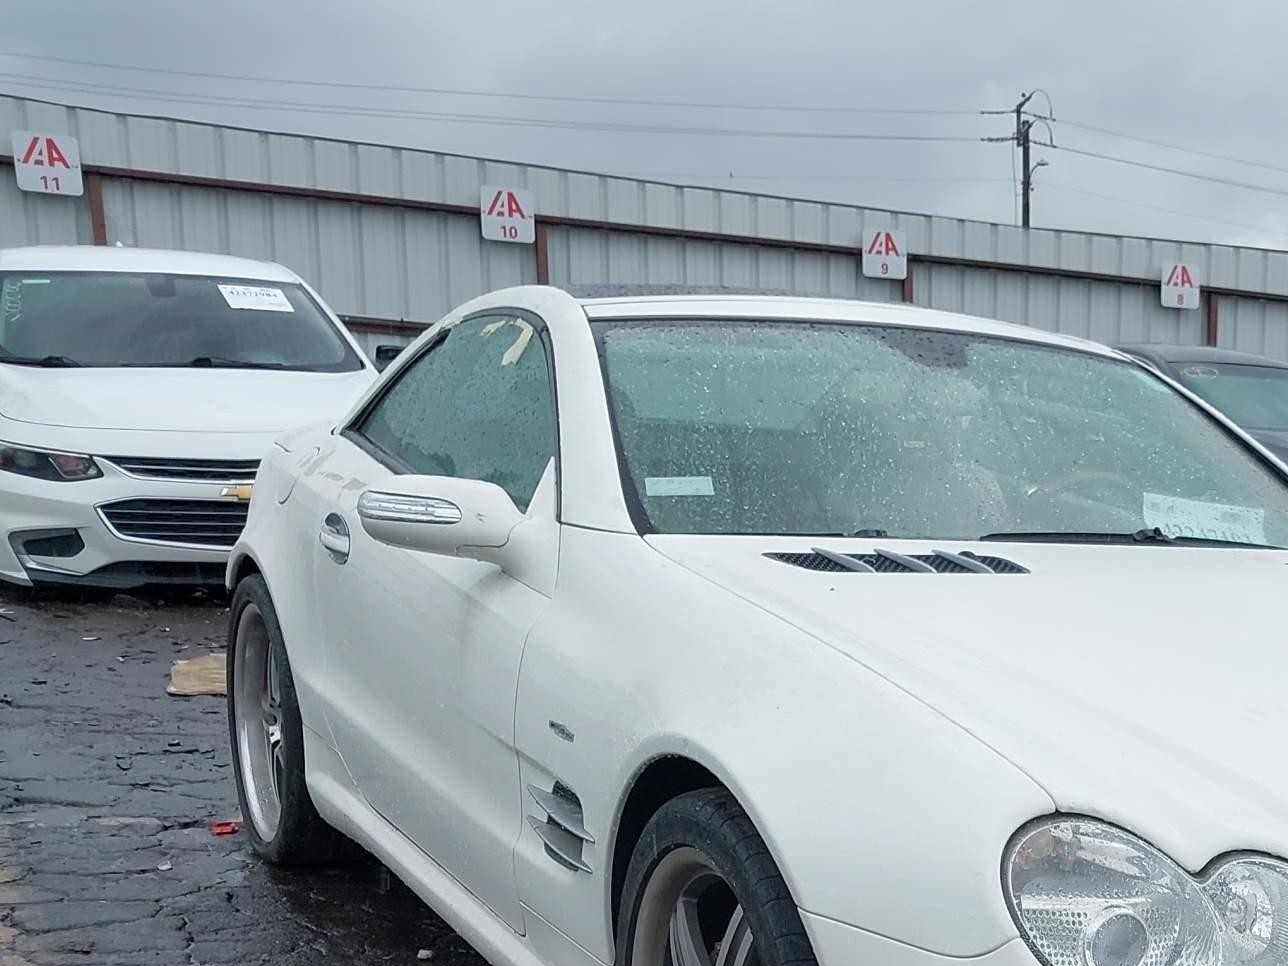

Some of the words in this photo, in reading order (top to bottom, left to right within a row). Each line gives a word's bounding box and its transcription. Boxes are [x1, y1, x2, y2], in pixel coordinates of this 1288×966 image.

[40, 176, 60, 190] 11
[500, 225, 518, 239] 10
[881, 262, 889, 275] 9
[1176, 294, 1184, 305] 8
